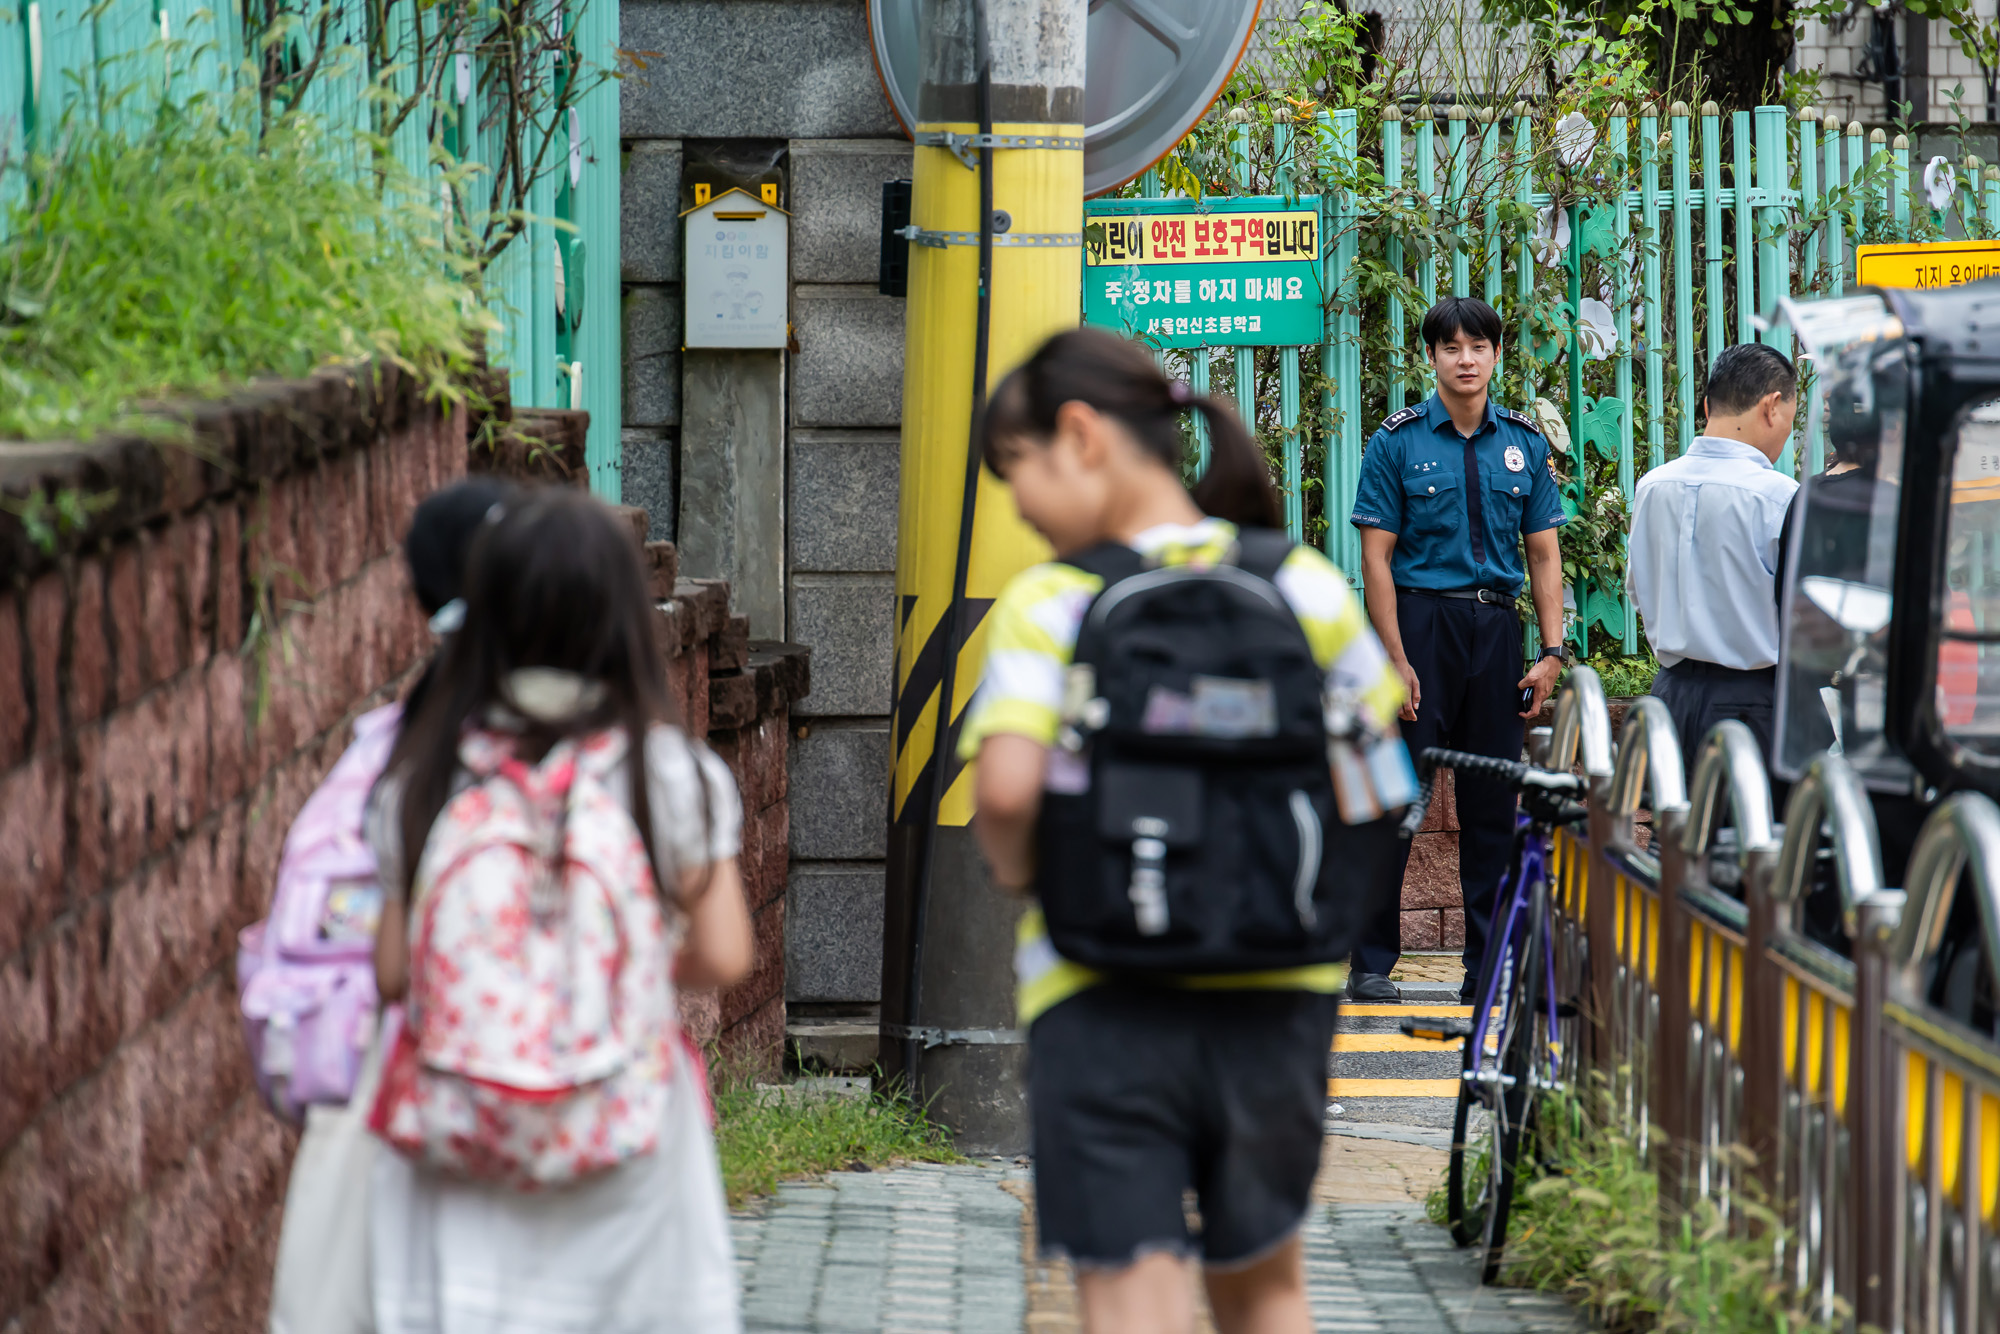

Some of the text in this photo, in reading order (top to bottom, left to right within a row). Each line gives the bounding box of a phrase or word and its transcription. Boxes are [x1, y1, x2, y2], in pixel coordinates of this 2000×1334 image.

[1151, 220, 1186, 258] 안전
[1194, 218, 1315, 257] 보호구역입니다
[704, 244, 769, 259] 지킴이함
[1199, 278, 1237, 303] 하지
[1245, 277, 1303, 302] 마세요
[1146, 316, 1262, 335] 서울연신초등학교
